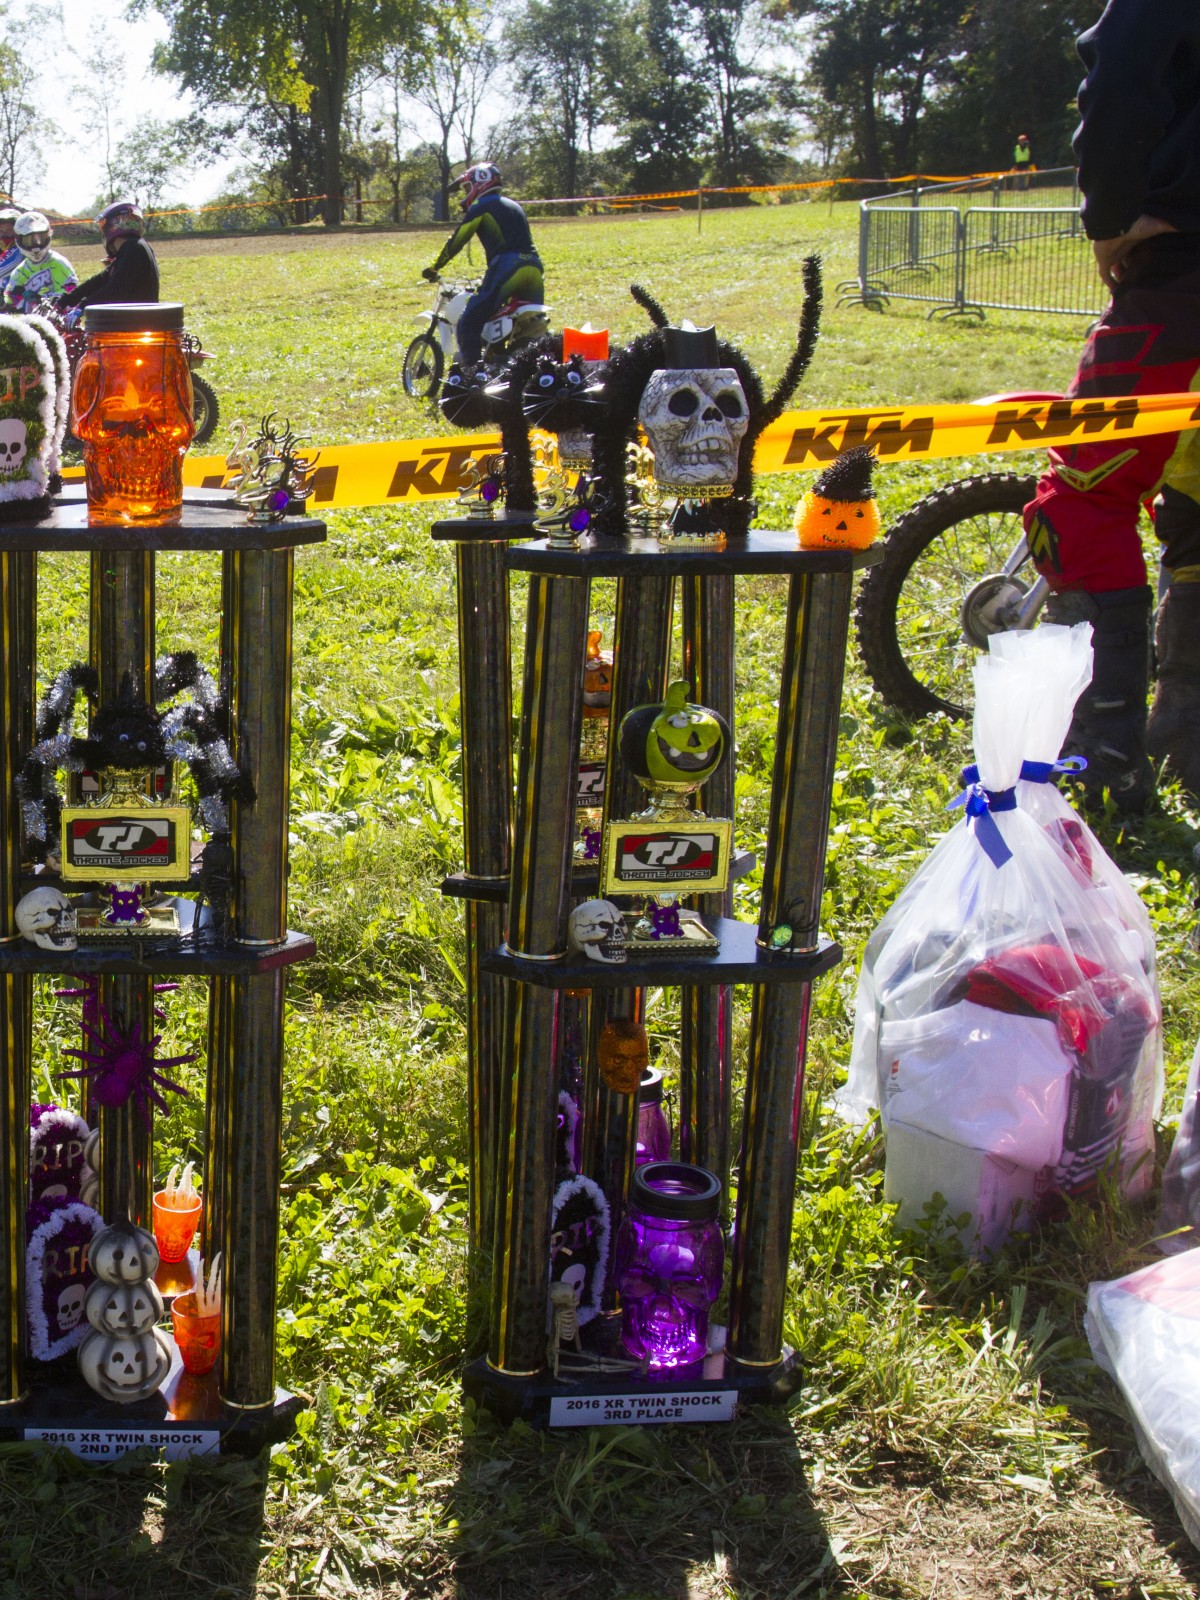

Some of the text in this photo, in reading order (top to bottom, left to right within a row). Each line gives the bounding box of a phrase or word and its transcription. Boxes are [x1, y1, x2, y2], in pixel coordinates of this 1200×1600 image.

[783, 411, 934, 465] KTM
[97, 826, 144, 850] TJ
[645, 841, 690, 865] TJ
[74, 855, 169, 866] THROTTLE JOCKEY
[621, 869, 711, 880] THROTTLE JOCKEY
[31, 1139, 83, 1173] RIP
[566, 1395, 722, 1410] 2016 XR TWIN SHOCK
[604, 1407, 683, 1420] 3RD PLACE
[41, 1432, 203, 1444] 2016 XR TWIN SHOCK
[80, 1444, 110, 1454] 2ND
